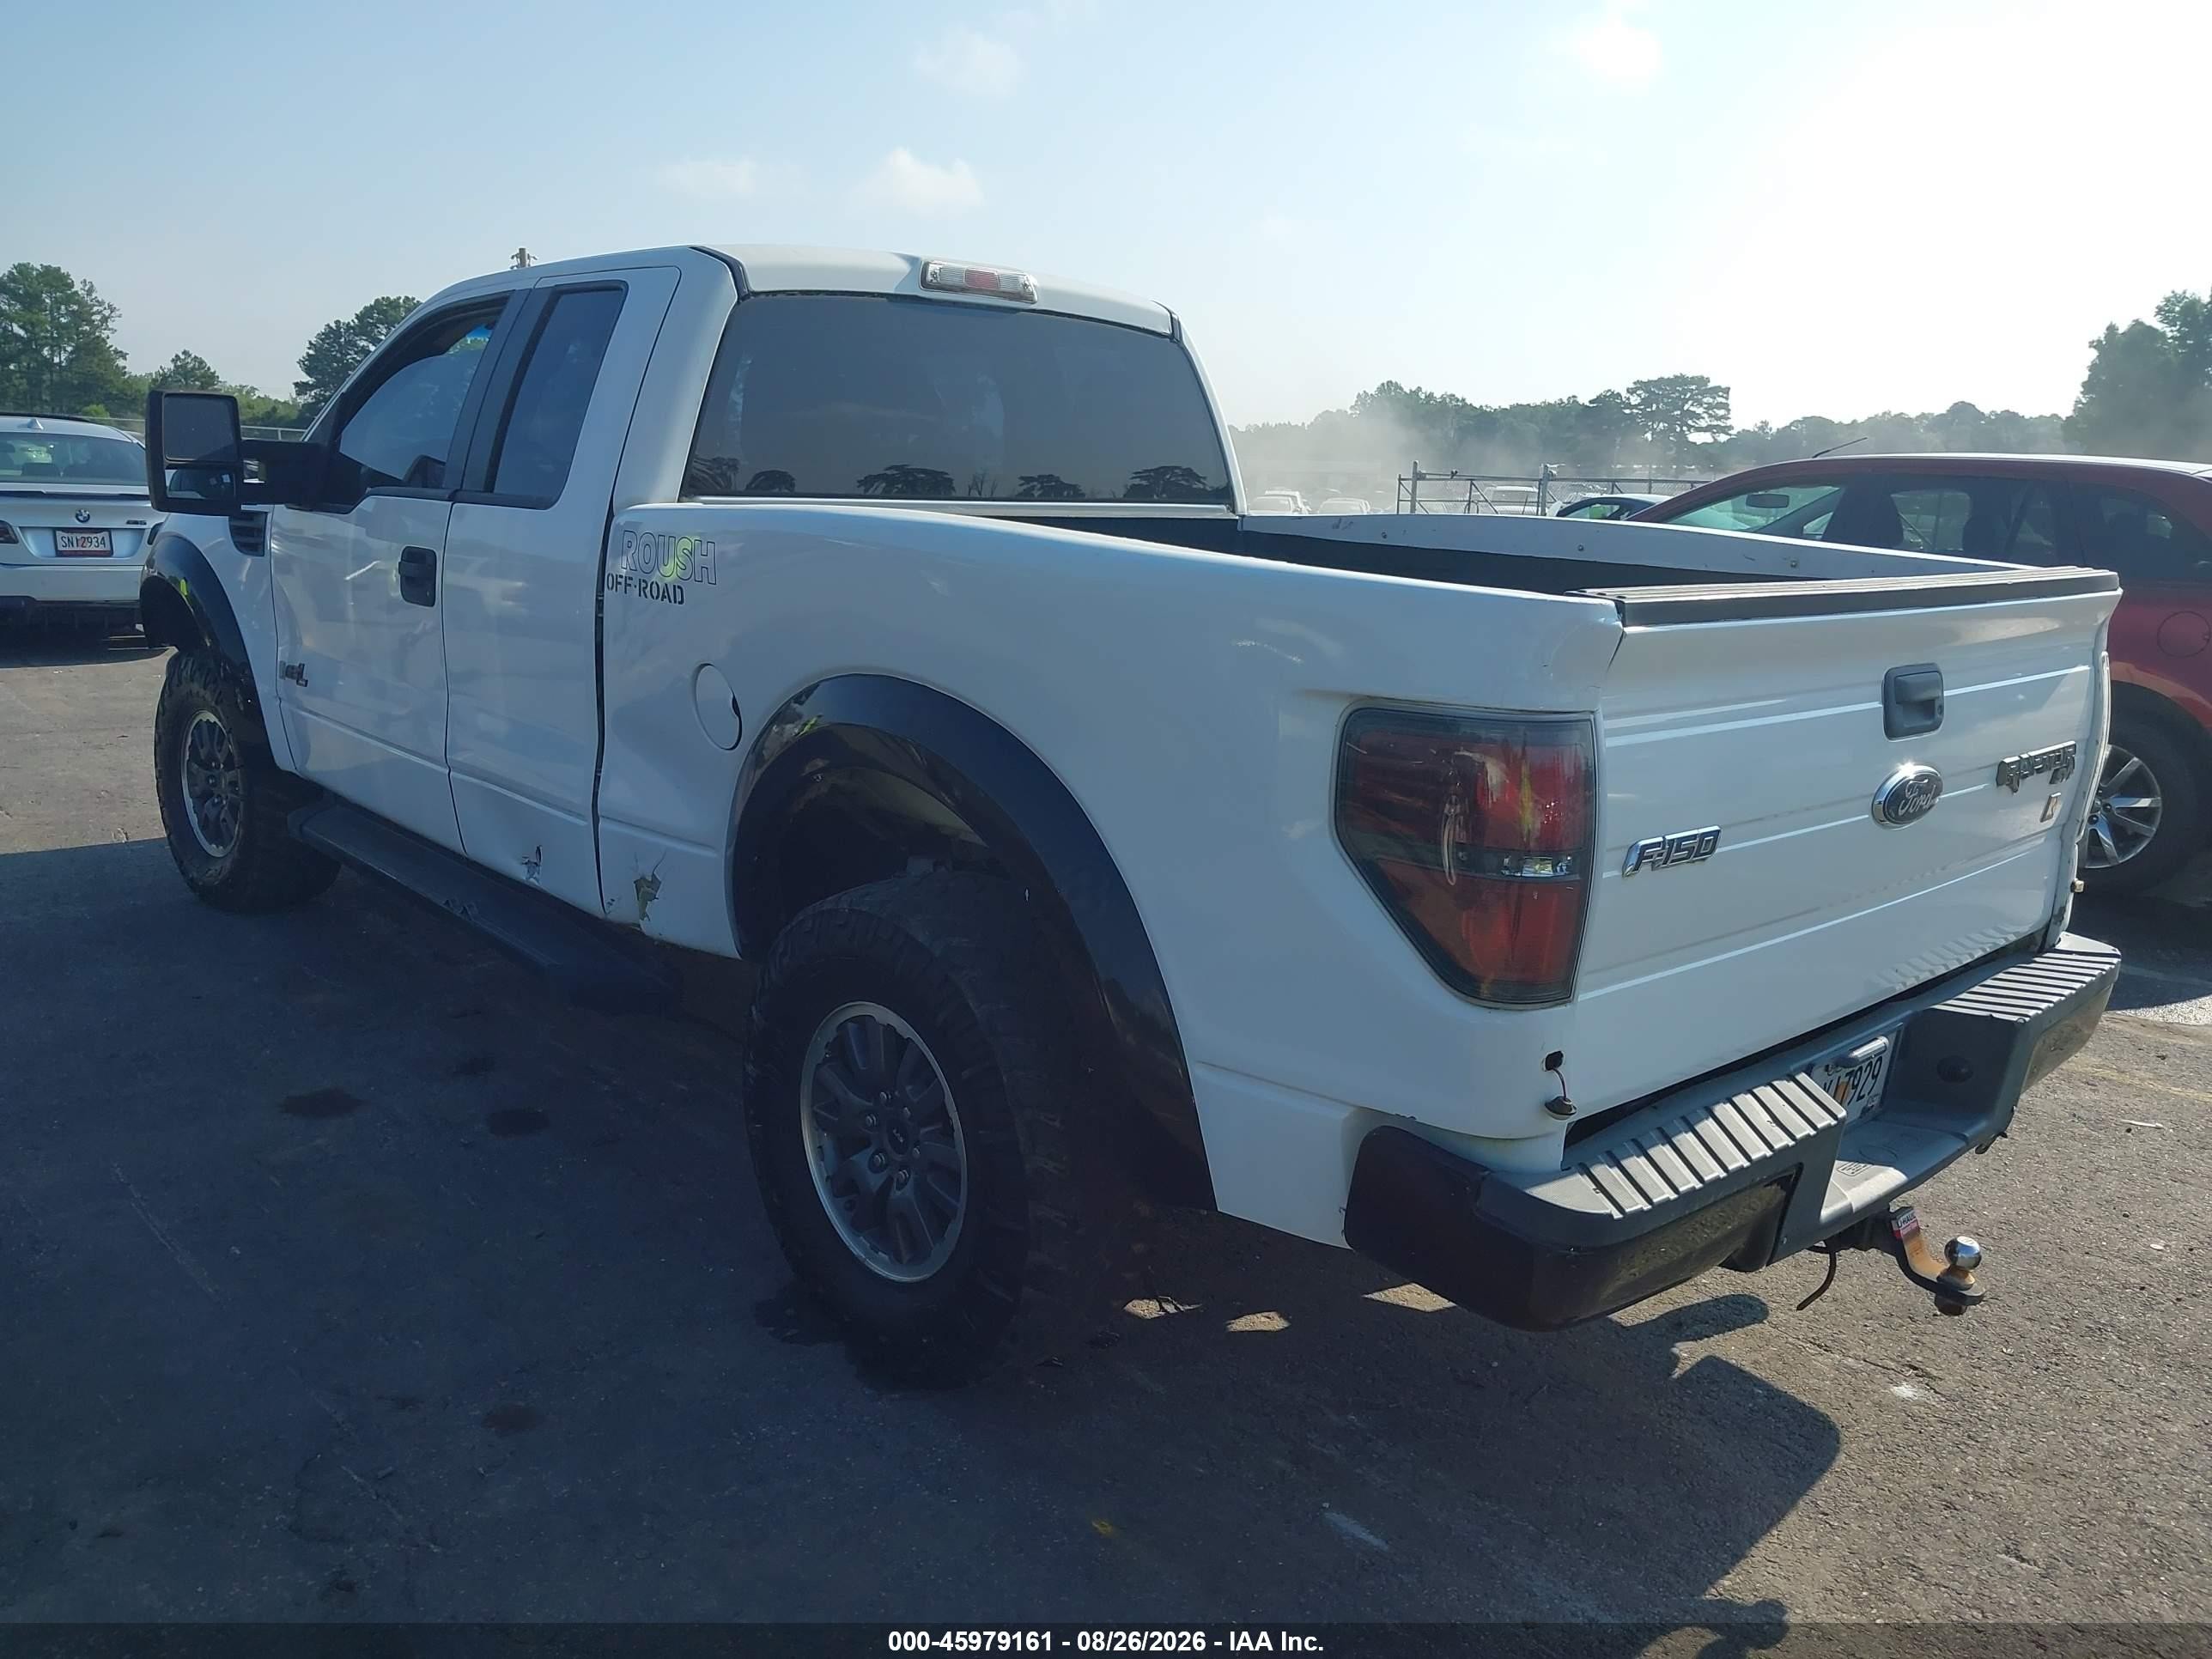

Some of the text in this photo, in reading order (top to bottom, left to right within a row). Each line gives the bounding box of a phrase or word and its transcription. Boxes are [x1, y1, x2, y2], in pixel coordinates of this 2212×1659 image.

[621, 530, 717, 586] ROUSH
[1898, 778, 1937, 817] Ford
[1621, 824, 1723, 877] F-150
